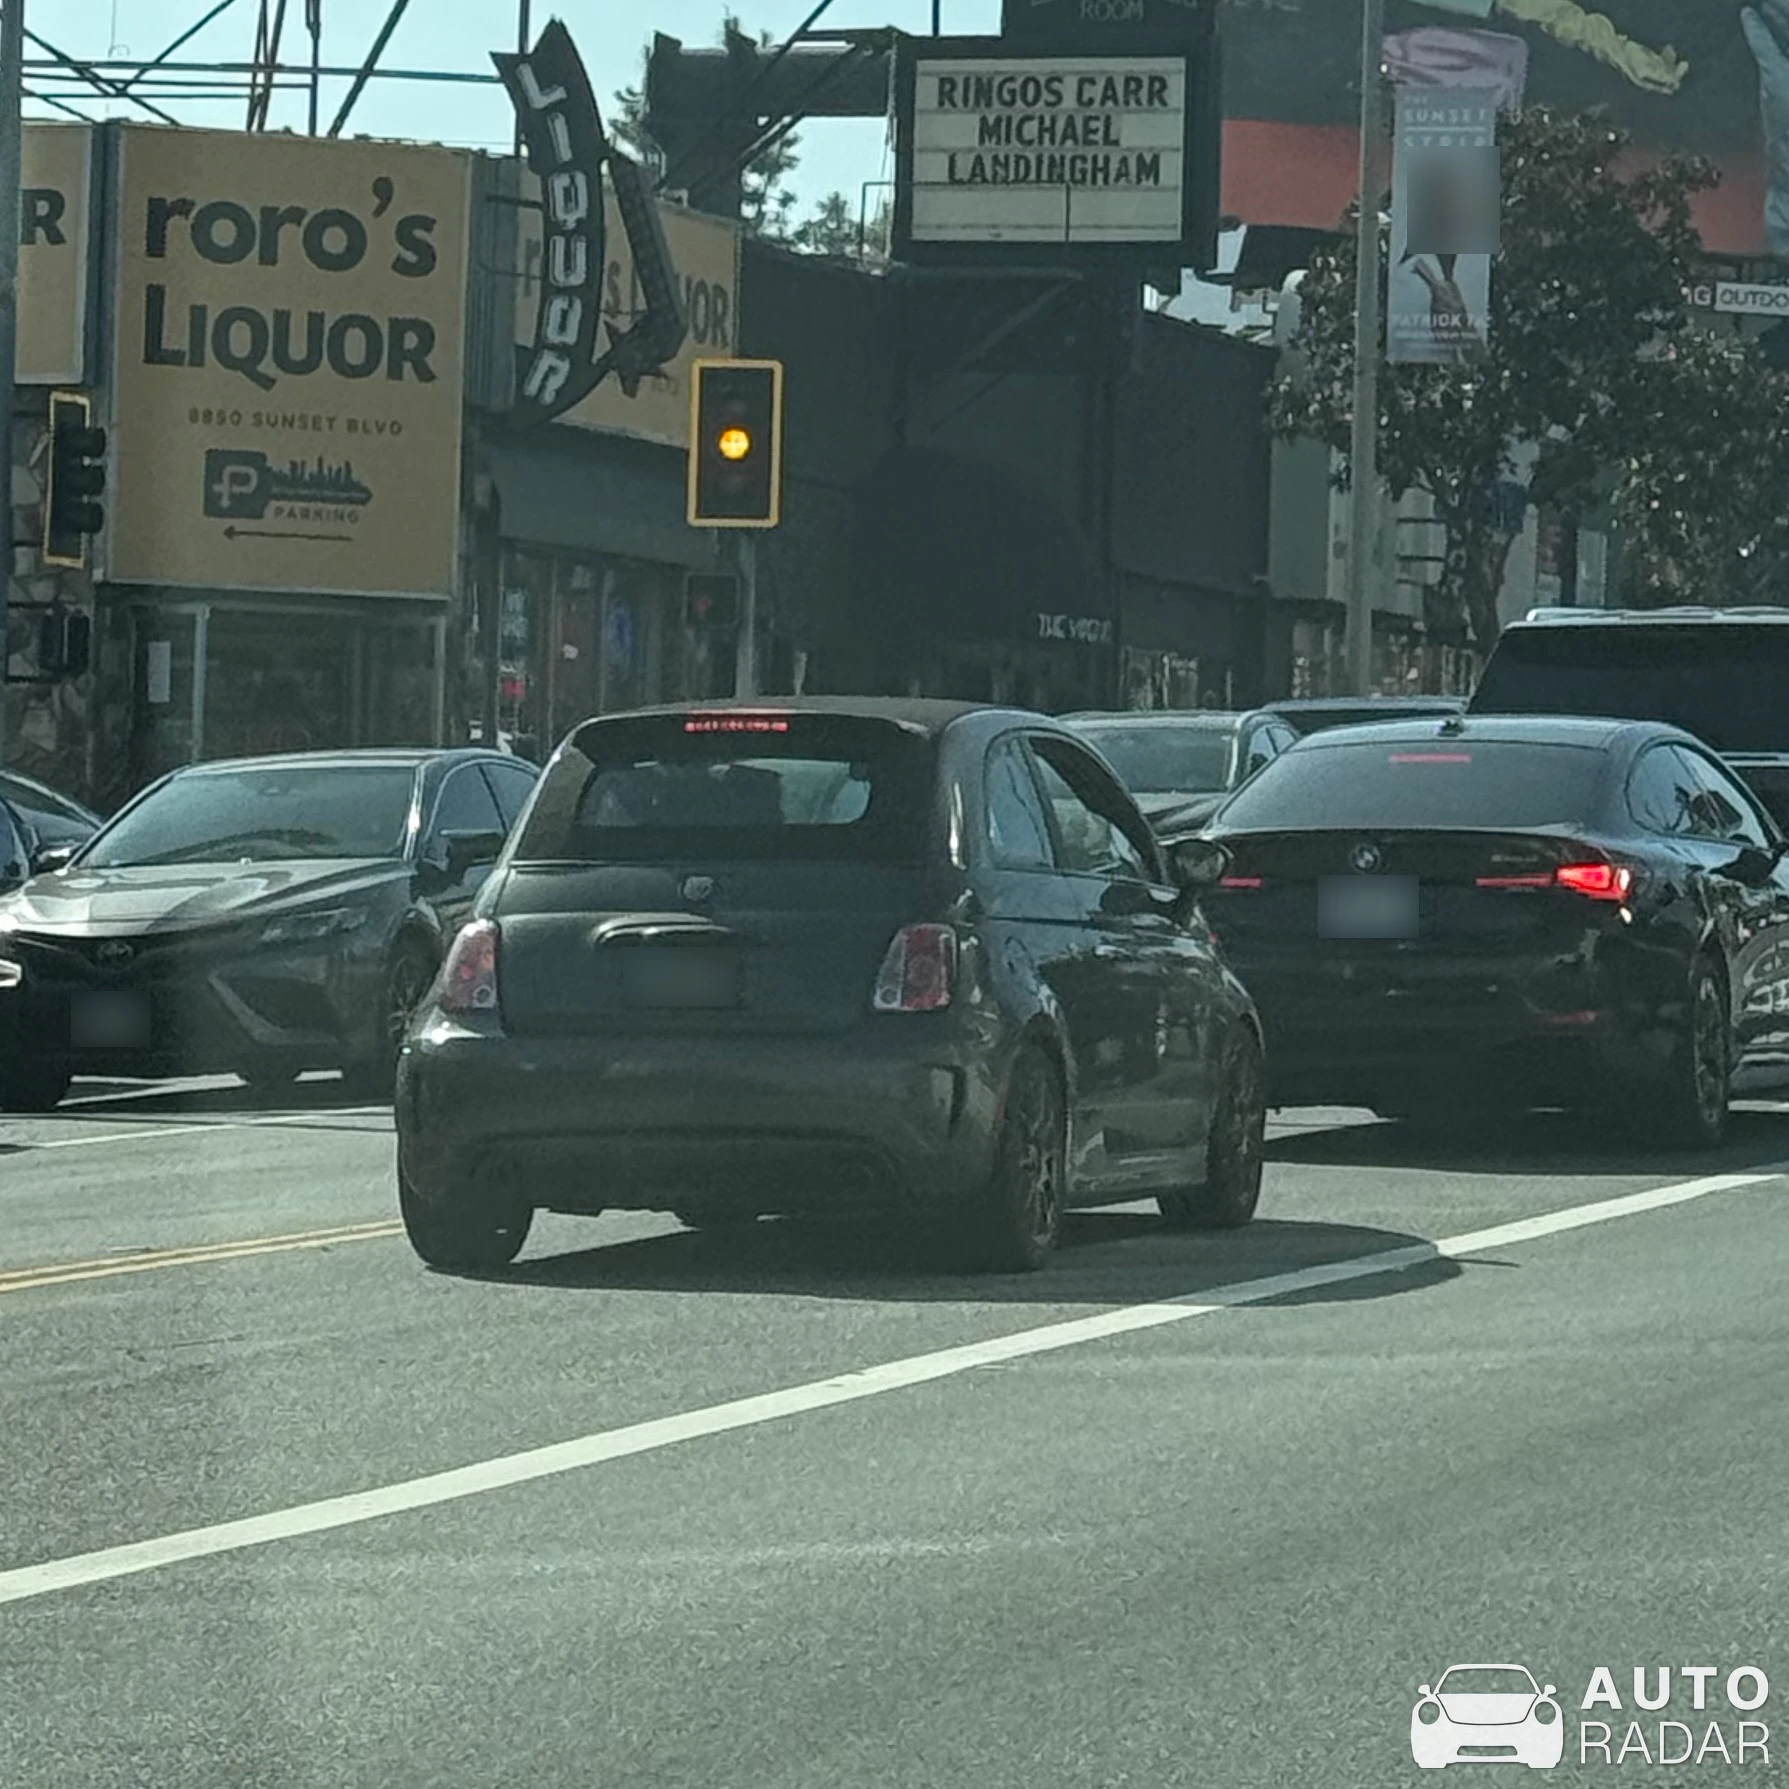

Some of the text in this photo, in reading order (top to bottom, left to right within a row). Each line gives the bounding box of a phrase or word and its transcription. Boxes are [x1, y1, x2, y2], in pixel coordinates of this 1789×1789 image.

[937, 76, 1063, 108] RINGOS
[977, 114, 1120, 147] MICHAEL
[1403, 108, 1487, 123] SUNSET
[947, 152, 1161, 186] LANDINGHAM
[145, 177, 437, 277] roro's
[515, 61, 588, 406] LIQUOR
[143, 284, 437, 390] LIQUOR
[188, 408, 243, 427] 8850
[252, 411, 337, 433] SUNSET
[273, 506, 360, 525] PARKING
